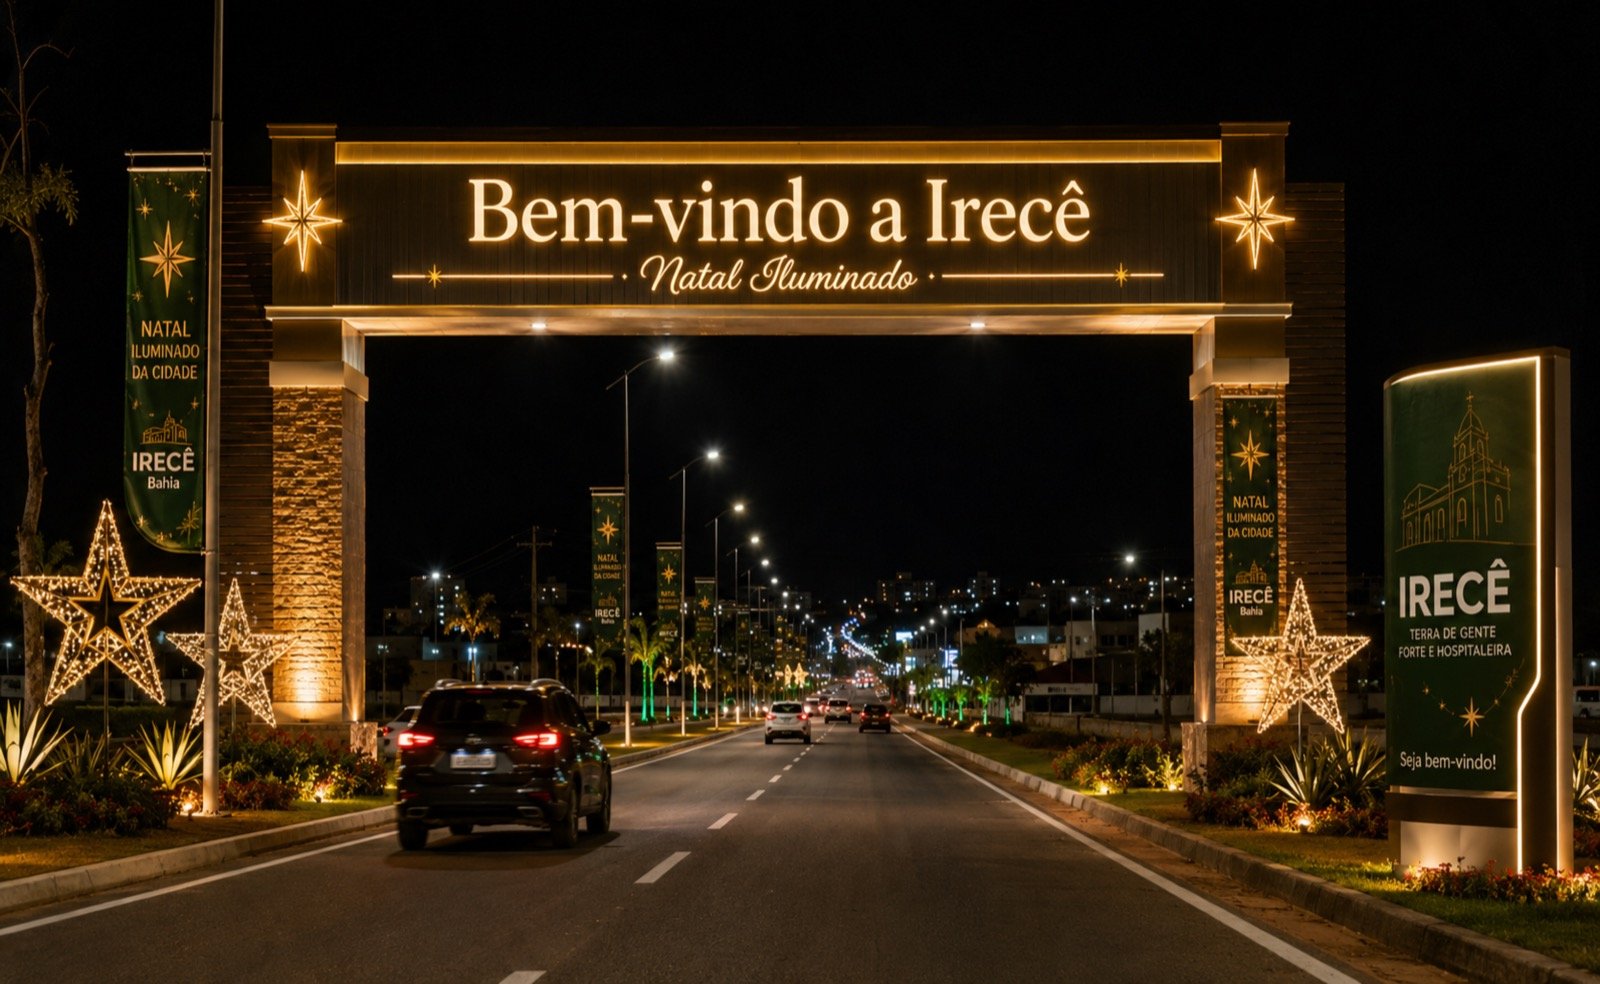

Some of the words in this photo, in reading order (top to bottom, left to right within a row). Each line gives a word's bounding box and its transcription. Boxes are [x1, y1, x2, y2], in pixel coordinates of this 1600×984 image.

[468, 175, 849, 243] Bem-vindo
[870, 198, 907, 243] a
[926, 178, 1090, 243] Irecê
[640, 255, 744, 295] Natal
[749, 254, 918, 292] Iluminado
[141, 320, 191, 337] NATAL
[131, 344, 200, 358] ILUMINADO
[132, 365, 148, 379] DA
[152, 365, 198, 379] CIDADE
[132, 447, 195, 472] IRECÊ
[147, 476, 180, 489] Bahia
[1233, 496, 1269, 508] NATAL
[1226, 513, 1275, 523] ILUMINADO
[1227, 527, 1240, 538] DA
[1241, 527, 1274, 538] CIDADE
[597, 554, 618, 562] NATAL
[1229, 586, 1274, 604] IRECÊ
[1400, 558, 1511, 618] IRECÊ
[594, 607, 620, 618] IRECÊ
[1240, 606, 1263, 616] Bahia
[1410, 627, 1440, 640] TERRA
[1443, 626, 1456, 639] DE
[1460, 625, 1496, 639] GENTE
[1399, 645, 1426, 658] FORTE
[1428, 645, 1434, 658] E
[1437, 643, 1512, 657] HOSPITALEIRA
[1400, 751, 1422, 771] Seja
[1425, 752, 1497, 771] bem-vindo!
